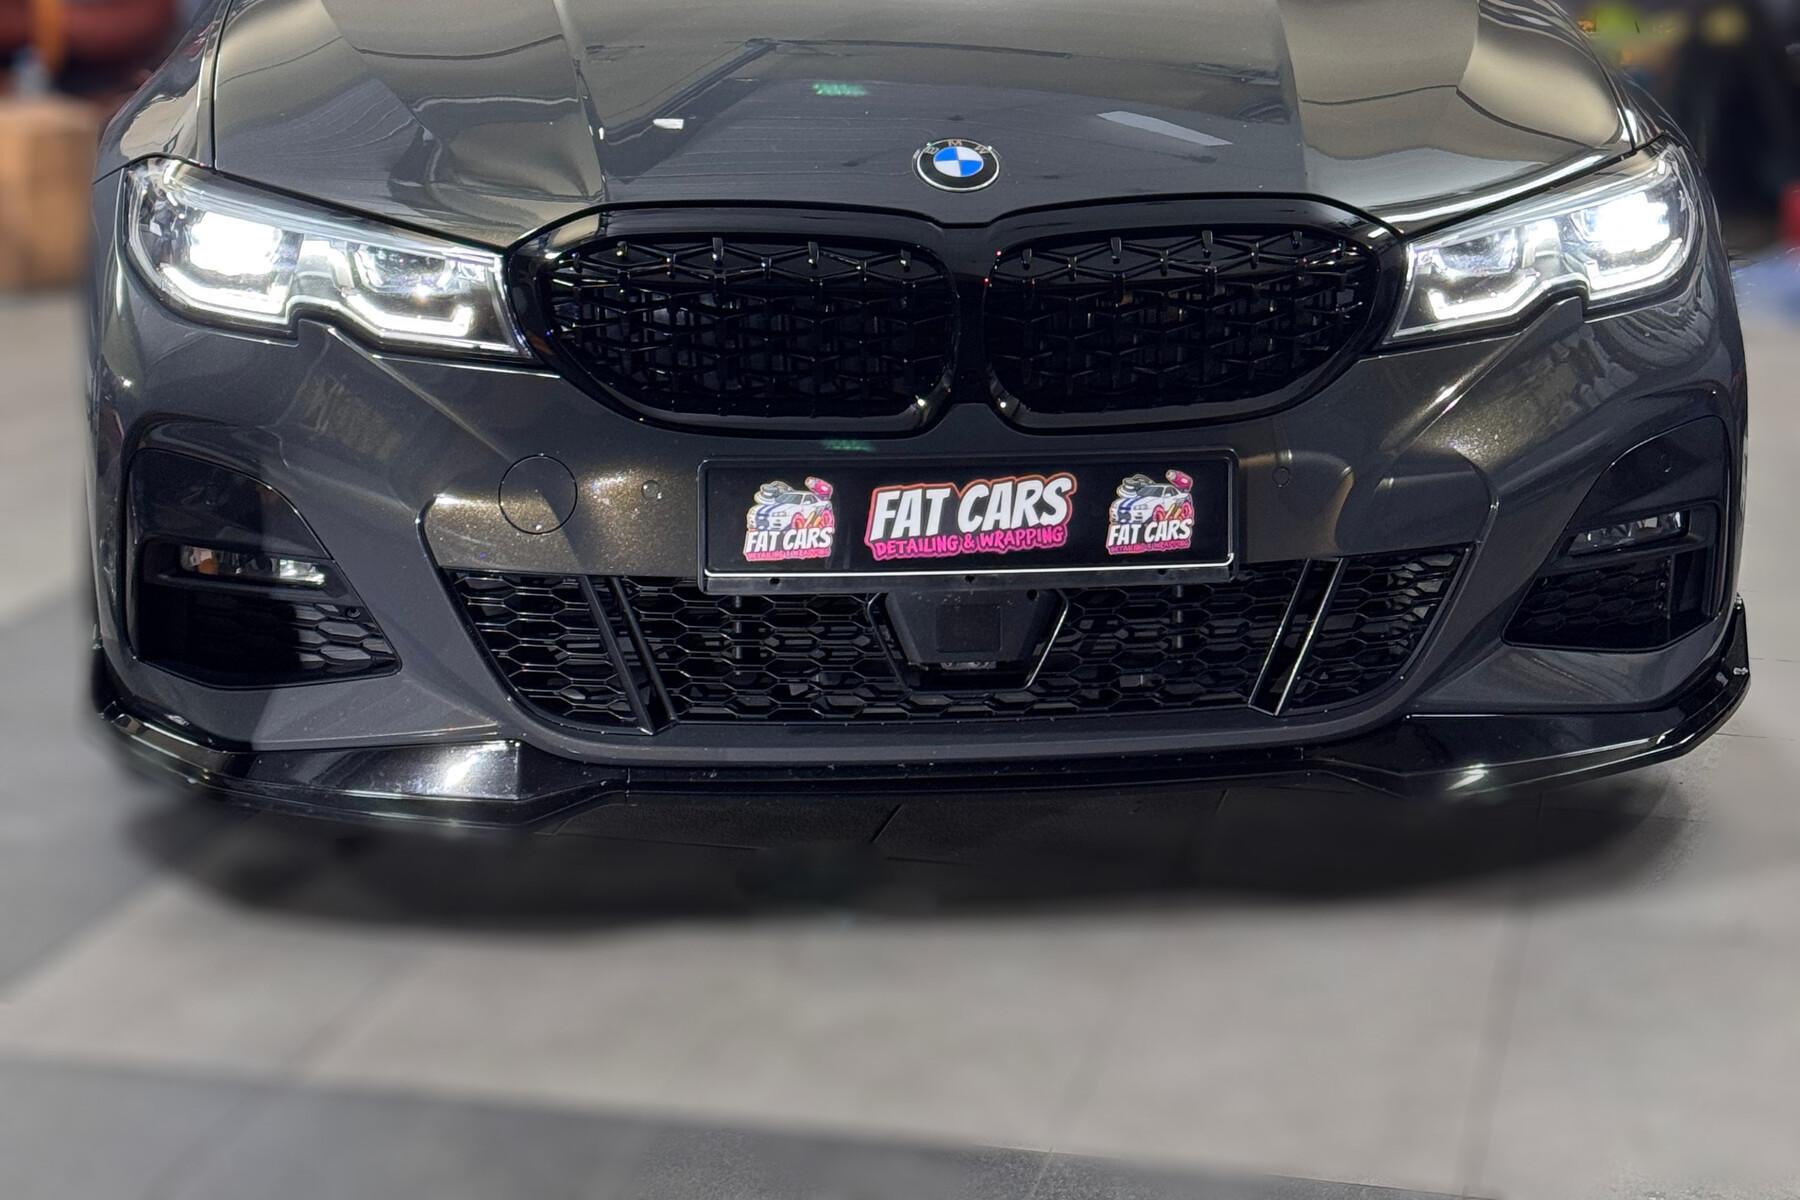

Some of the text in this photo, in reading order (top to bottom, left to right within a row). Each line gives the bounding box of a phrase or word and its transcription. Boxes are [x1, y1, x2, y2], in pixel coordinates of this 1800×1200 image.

[924, 139, 990, 155] BMW
[870, 477, 1072, 541] FAT CARS
[746, 527, 833, 553] FAT CARS
[874, 526, 1065, 556] DETAILING & WRAPPING
[1108, 525, 1142, 547] FAT
[1144, 519, 1192, 543] CARS
